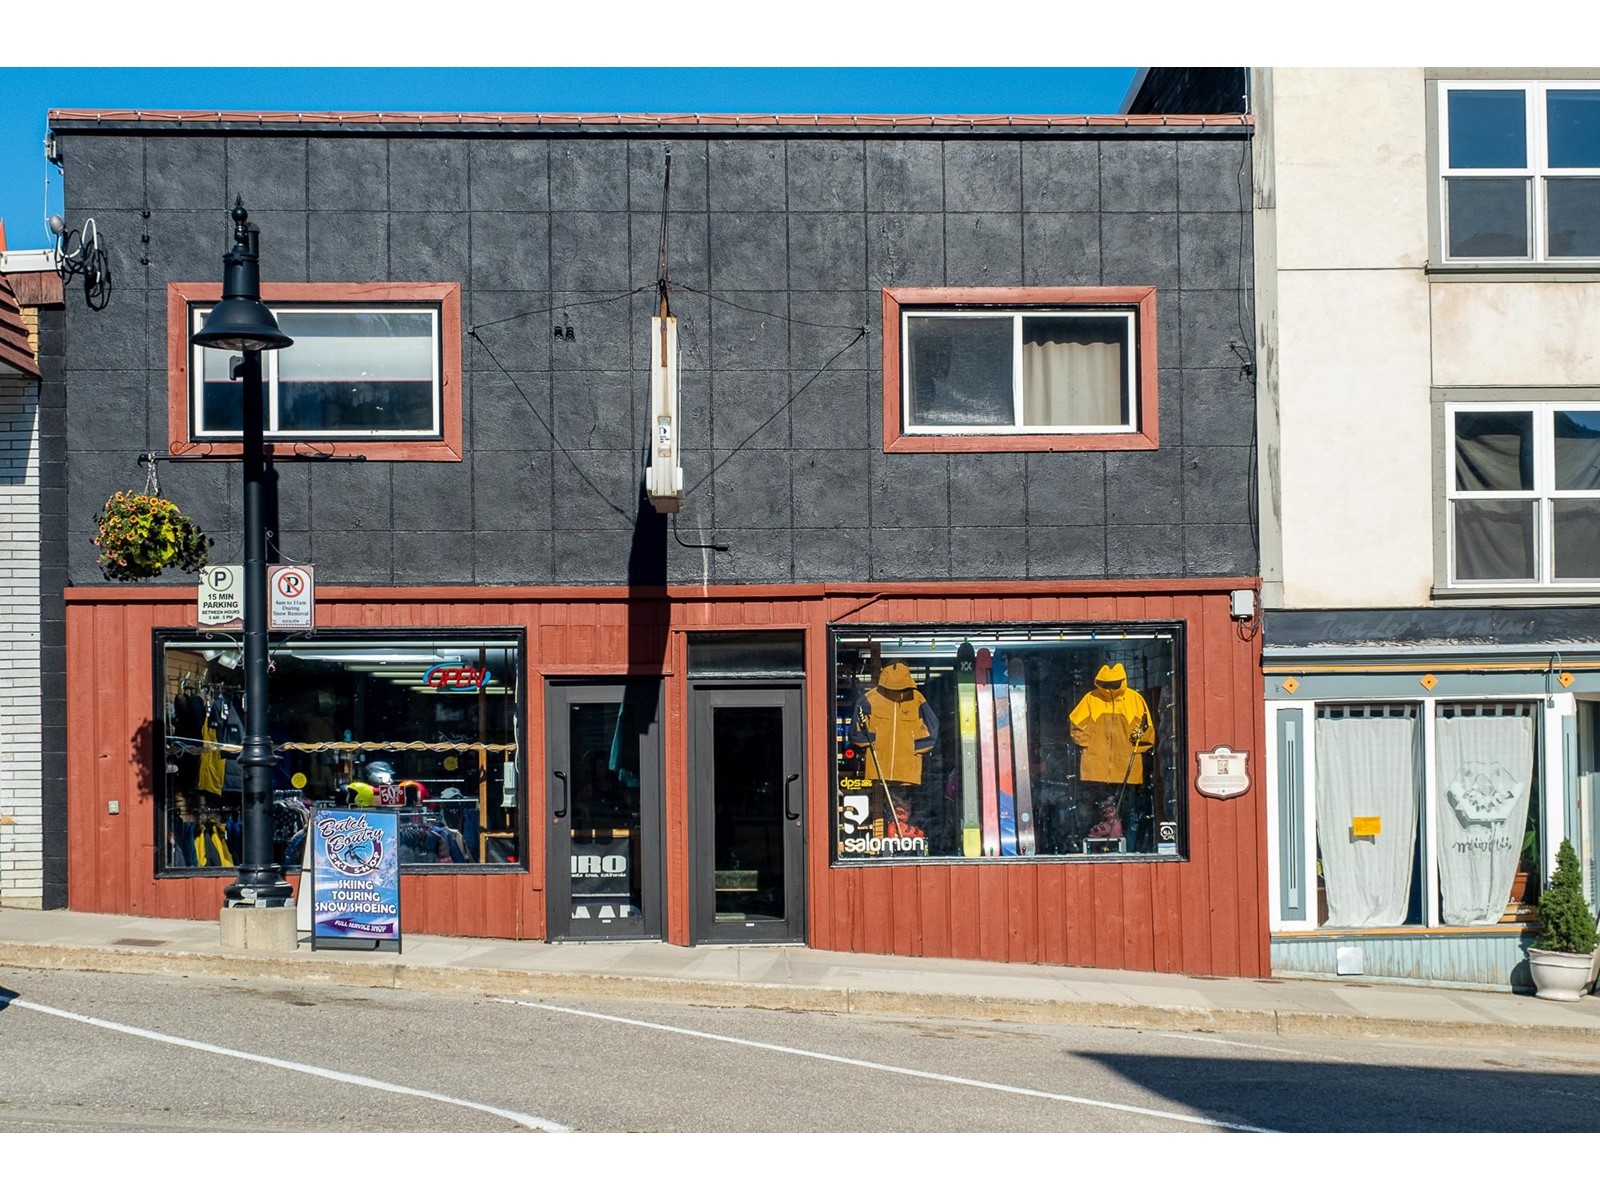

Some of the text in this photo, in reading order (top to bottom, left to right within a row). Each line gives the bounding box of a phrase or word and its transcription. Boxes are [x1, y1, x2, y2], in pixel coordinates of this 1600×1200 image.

[214, 571, 227, 587] P
[428, 667, 487, 688] OPEN
[840, 776, 861, 790] dps
[381, 785, 404, 803] 50%
[318, 813, 367, 838] Butch
[329, 827, 384, 853] Boutry
[844, 832, 924, 853] salomon
[338, 879, 374, 890] SKIING
[331, 891, 381, 902] TOURING
[315, 902, 397, 914] SNOW SHOEING
[348, 922, 370, 931] SERVICE
